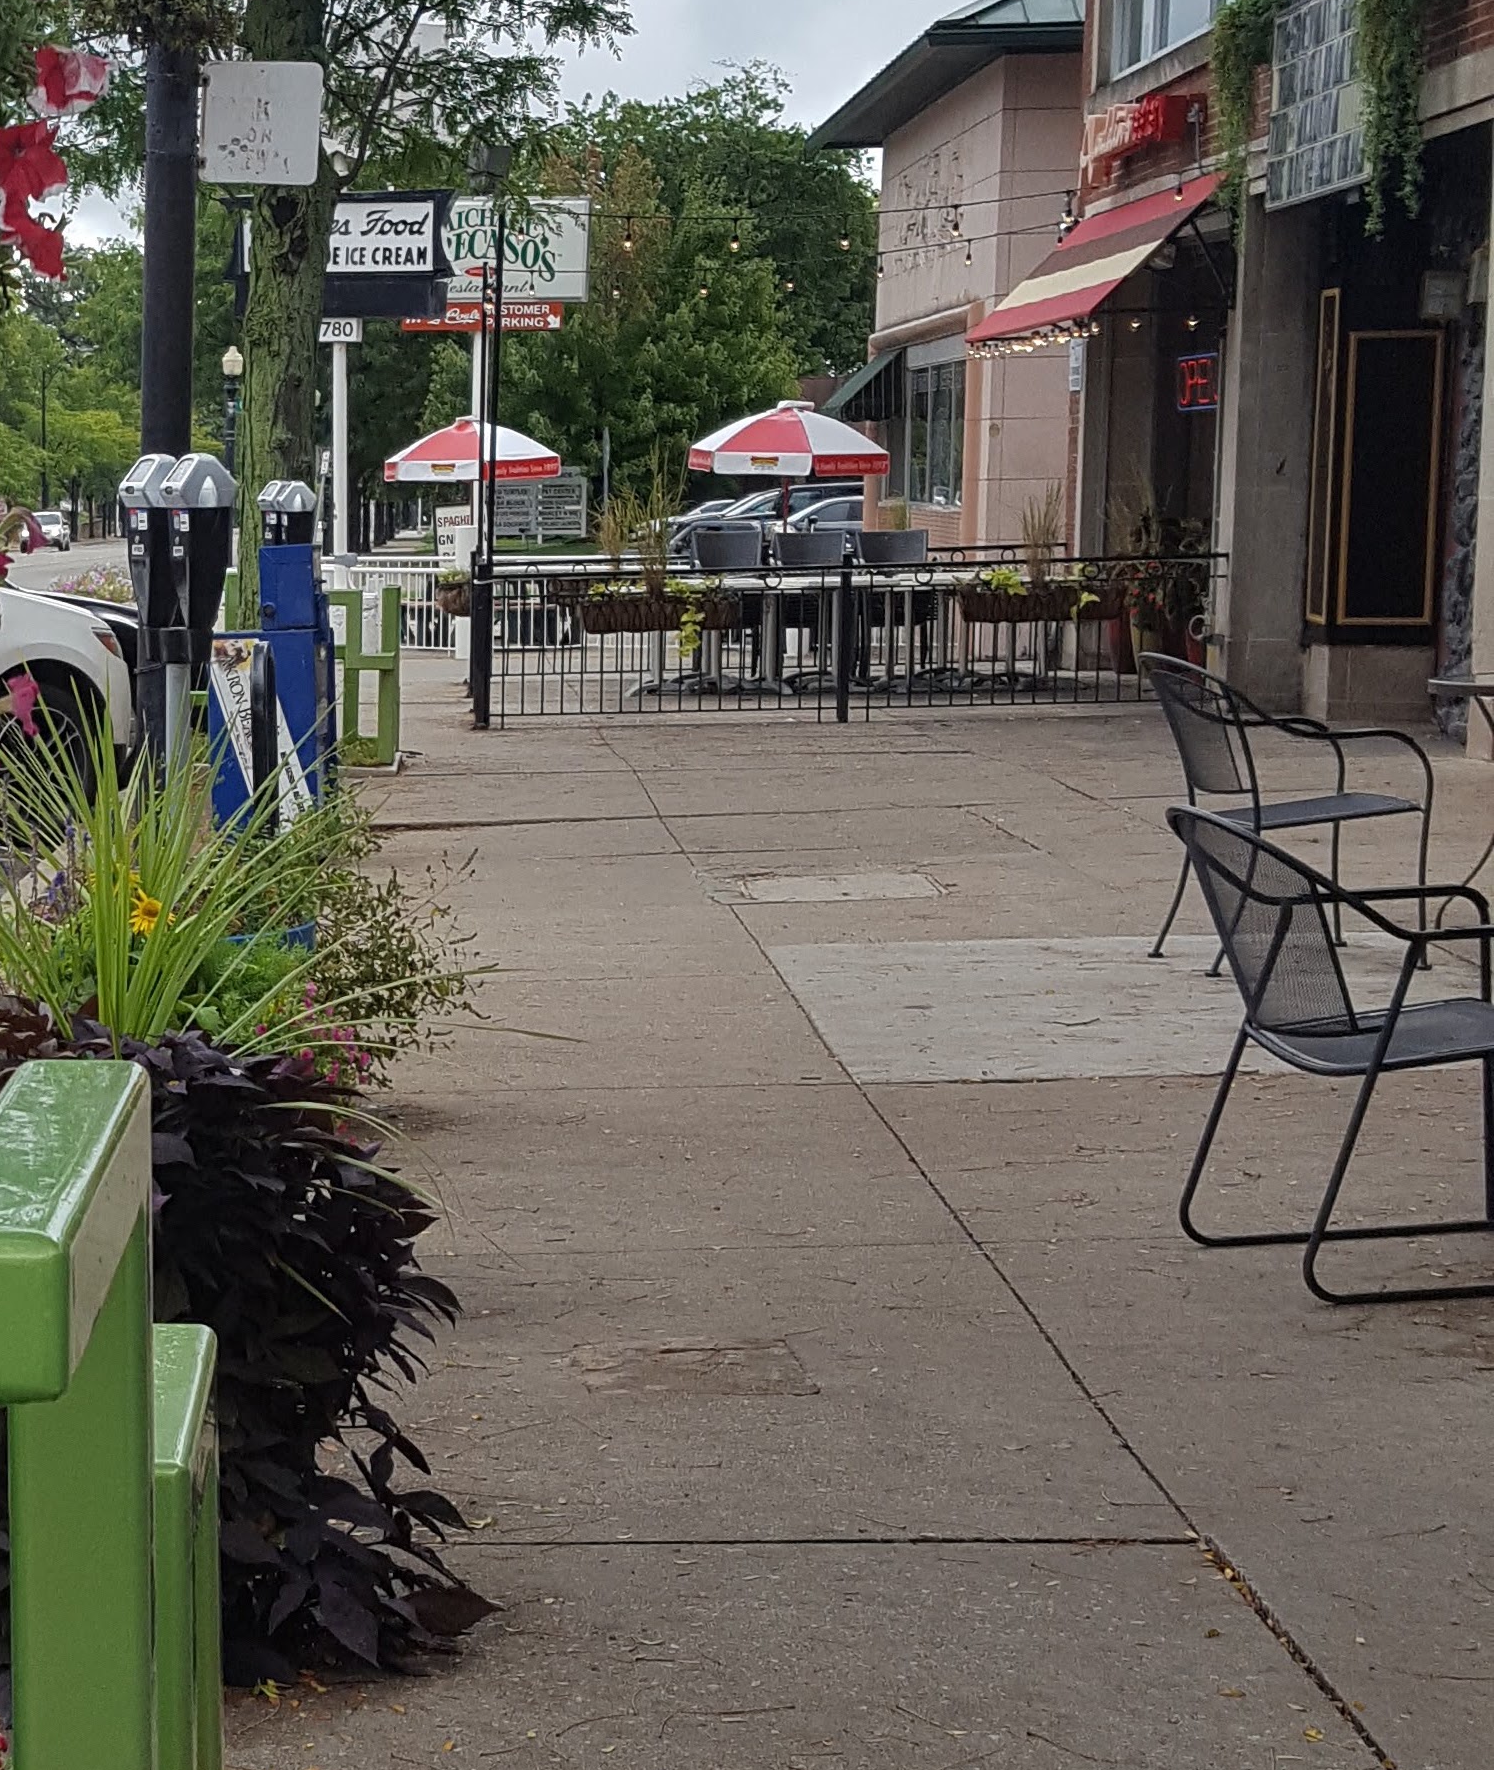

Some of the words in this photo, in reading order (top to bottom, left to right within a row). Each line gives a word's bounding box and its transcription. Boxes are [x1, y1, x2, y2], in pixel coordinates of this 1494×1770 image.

[360, 208, 430, 236] Food
[345, 246, 366, 266] ICE
[371, 246, 428, 266] CREAM
[446, 227, 556, 283] ECASO'S
[321, 321, 354, 337] 780
[486, 316, 544, 328] PRKING
[1179, 358, 1219, 406] OPE
